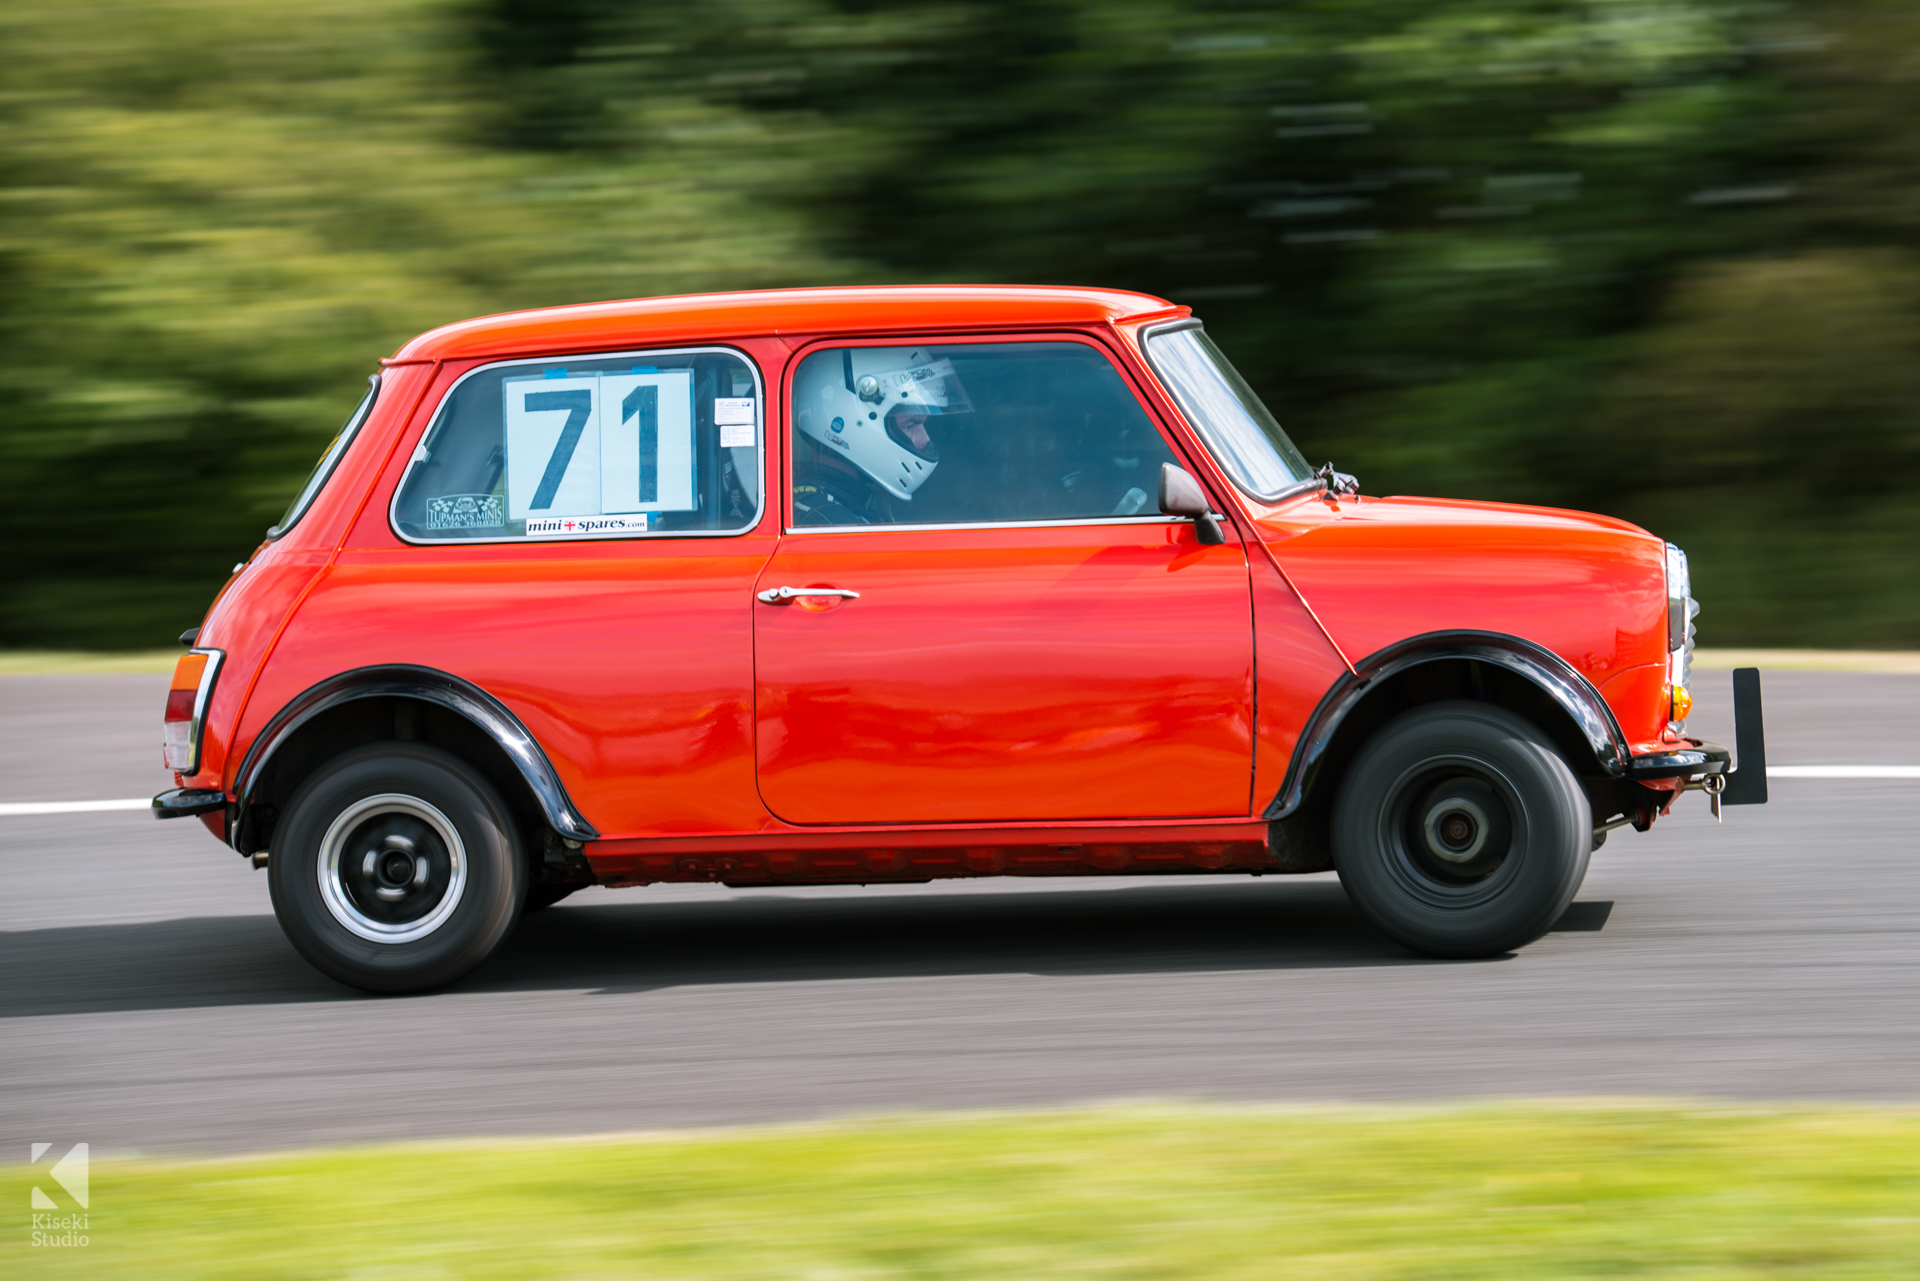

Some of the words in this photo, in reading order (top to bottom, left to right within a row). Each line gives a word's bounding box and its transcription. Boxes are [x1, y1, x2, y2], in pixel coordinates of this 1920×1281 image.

[525, 385, 658, 510] 71
[429, 509, 475, 522] TUPMAN'S
[476, 505, 502, 521] MINIS
[528, 520, 562, 531] mini
[578, 519, 645, 531] spares.com
